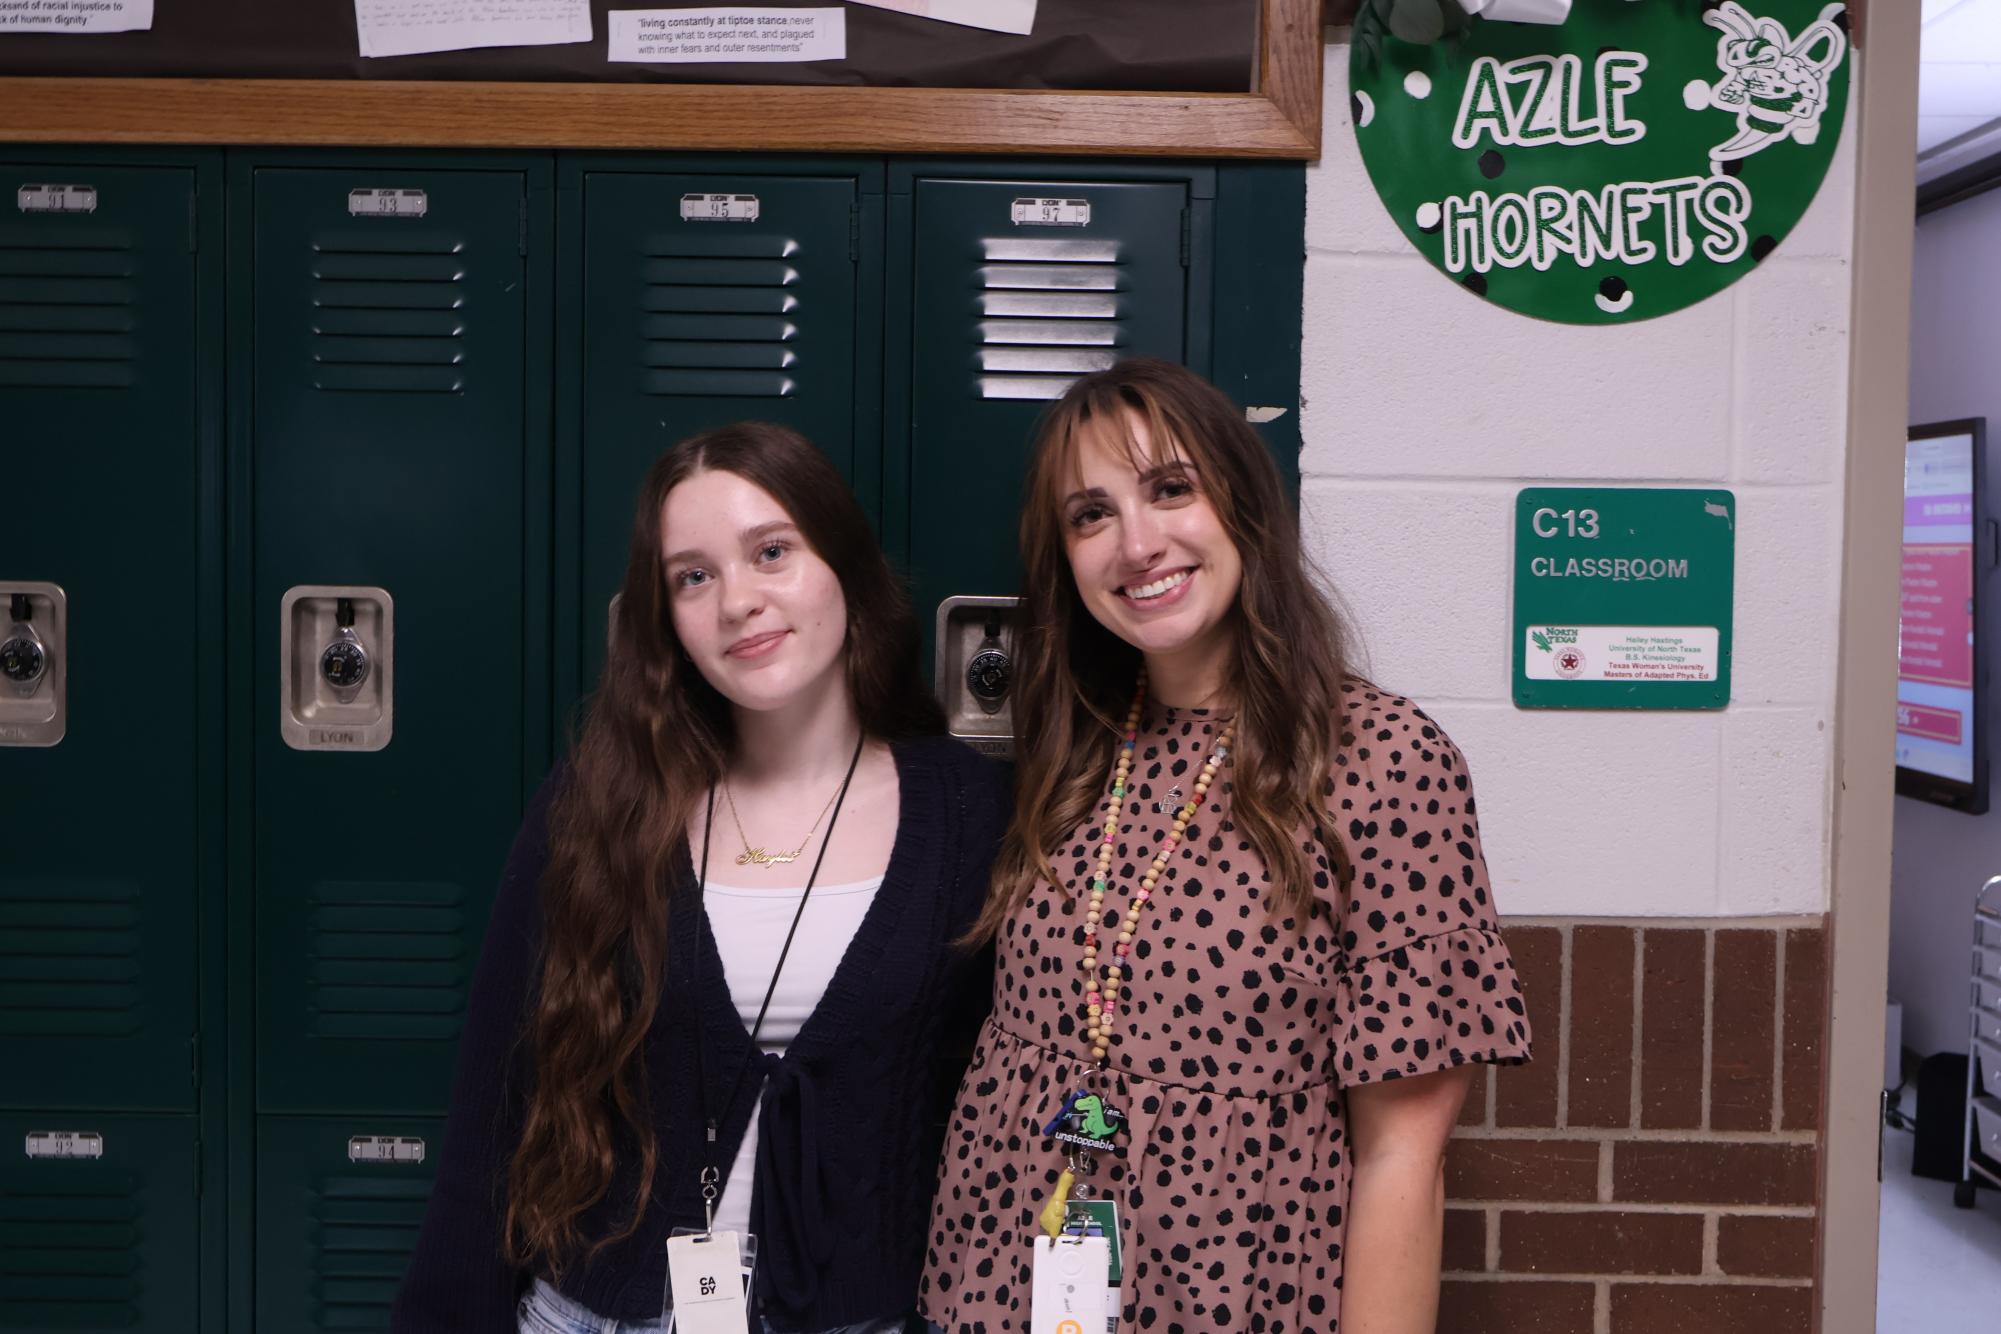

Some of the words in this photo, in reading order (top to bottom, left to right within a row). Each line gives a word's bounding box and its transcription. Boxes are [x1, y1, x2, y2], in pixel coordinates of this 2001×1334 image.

[9, 14, 19, 24] of
[20, 15, 52, 24] human
[668, 16, 714, 28] constantly
[717, 16, 727, 25] at
[728, 16, 755, 27] tiptoe
[790, 17, 815, 25] never
[638, 32, 673, 43] knowing
[674, 31, 696, 40] what
[697, 30, 706, 39] to
[707, 30, 737, 41] expect
[761, 30, 778, 39] and
[780, 30, 815, 41] plagued
[638, 45, 655, 54] with
[657, 45, 679, 54] inner
[681, 43, 702, 53] fears
[704, 43, 720, 53] and
[722, 44, 745, 53] outer
[1452, 51, 1648, 149] AZLE
[711, 203, 729, 218] 95
[1042, 206, 1061, 222] 97
[1443, 175, 1751, 273] HORNETS
[1532, 507, 1599, 538] C13
[1531, 556, 1689, 579] CLASSROOM
[1546, 627, 1578, 637] NORTH
[1548, 635, 1578, 644] TEXAS
[1608, 645, 1646, 654] University
[1648, 645, 1657, 653] of
[1658, 646, 1679, 654] North
[1609, 662, 1631, 670] Texas
[1632, 662, 1666, 671] Woman's
[1667, 663, 1705, 672] University
[1603, 670, 1633, 679] Masters
[1634, 670, 1643, 679] of
[1644, 671, 1675, 681] Adapted
[320, 730, 353, 743] LYON
[1055, 1129, 1115, 1151] unstoppable
